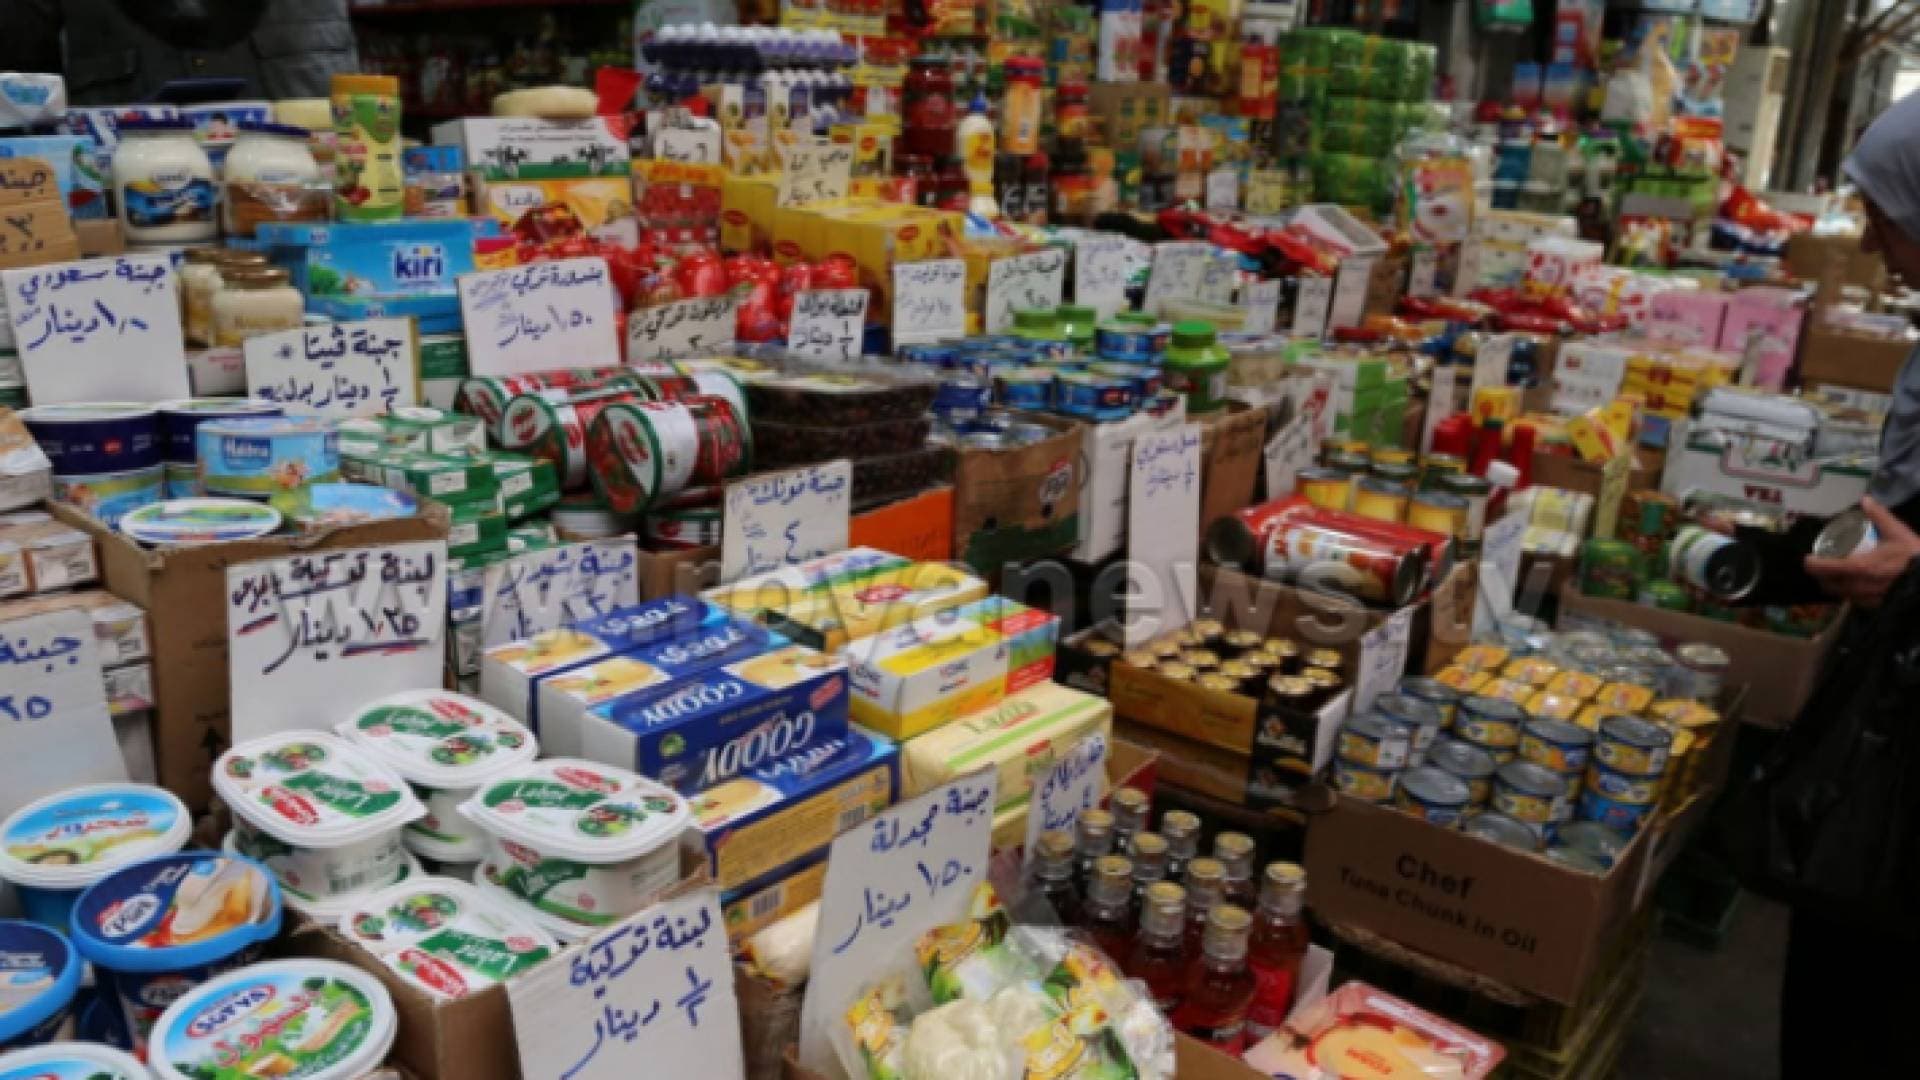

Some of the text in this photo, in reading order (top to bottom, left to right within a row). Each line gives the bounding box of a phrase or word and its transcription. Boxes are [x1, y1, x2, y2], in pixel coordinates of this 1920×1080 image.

[395, 246, 443, 279] kiri
[380, 553, 434, 596] لبنة
[1395, 852, 1474, 902] Chef
[652, 906, 712, 950] لبنة
[1394, 886, 1468, 931] Chunk
